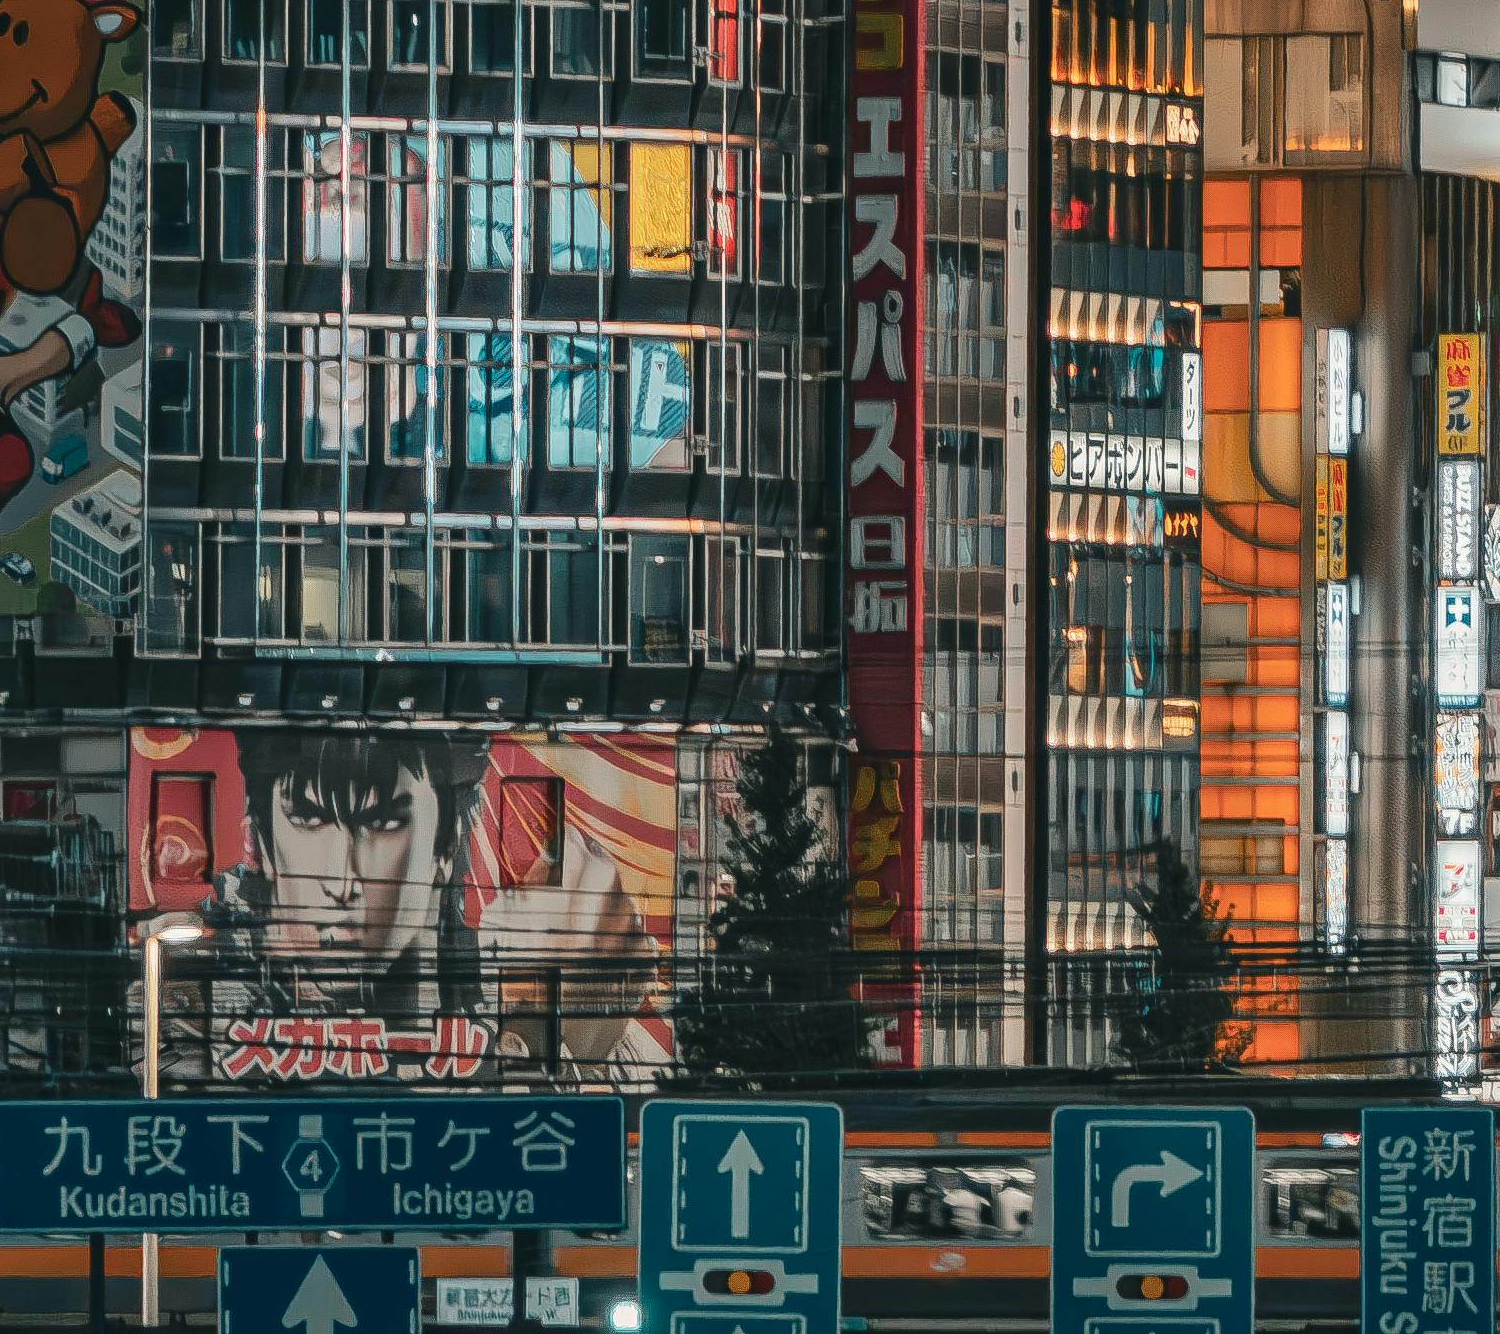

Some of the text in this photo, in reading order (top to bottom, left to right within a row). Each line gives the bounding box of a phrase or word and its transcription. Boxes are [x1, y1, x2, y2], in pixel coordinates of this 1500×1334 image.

[852, 97, 907, 489] エスパス
[1186, 359, 1197, 431] ダーツ
[849, 514, 909, 633] 日拓
[222, 1017, 495, 1079] メガホール
[42, 1114, 270, 1176] 九段下
[299, 1149, 322, 1182] 4
[59, 1183, 251, 1219] Kudanshita
[392, 1181, 535, 1221] Ichigaya
[1371, 1135, 1417, 1296] Shinjuku
